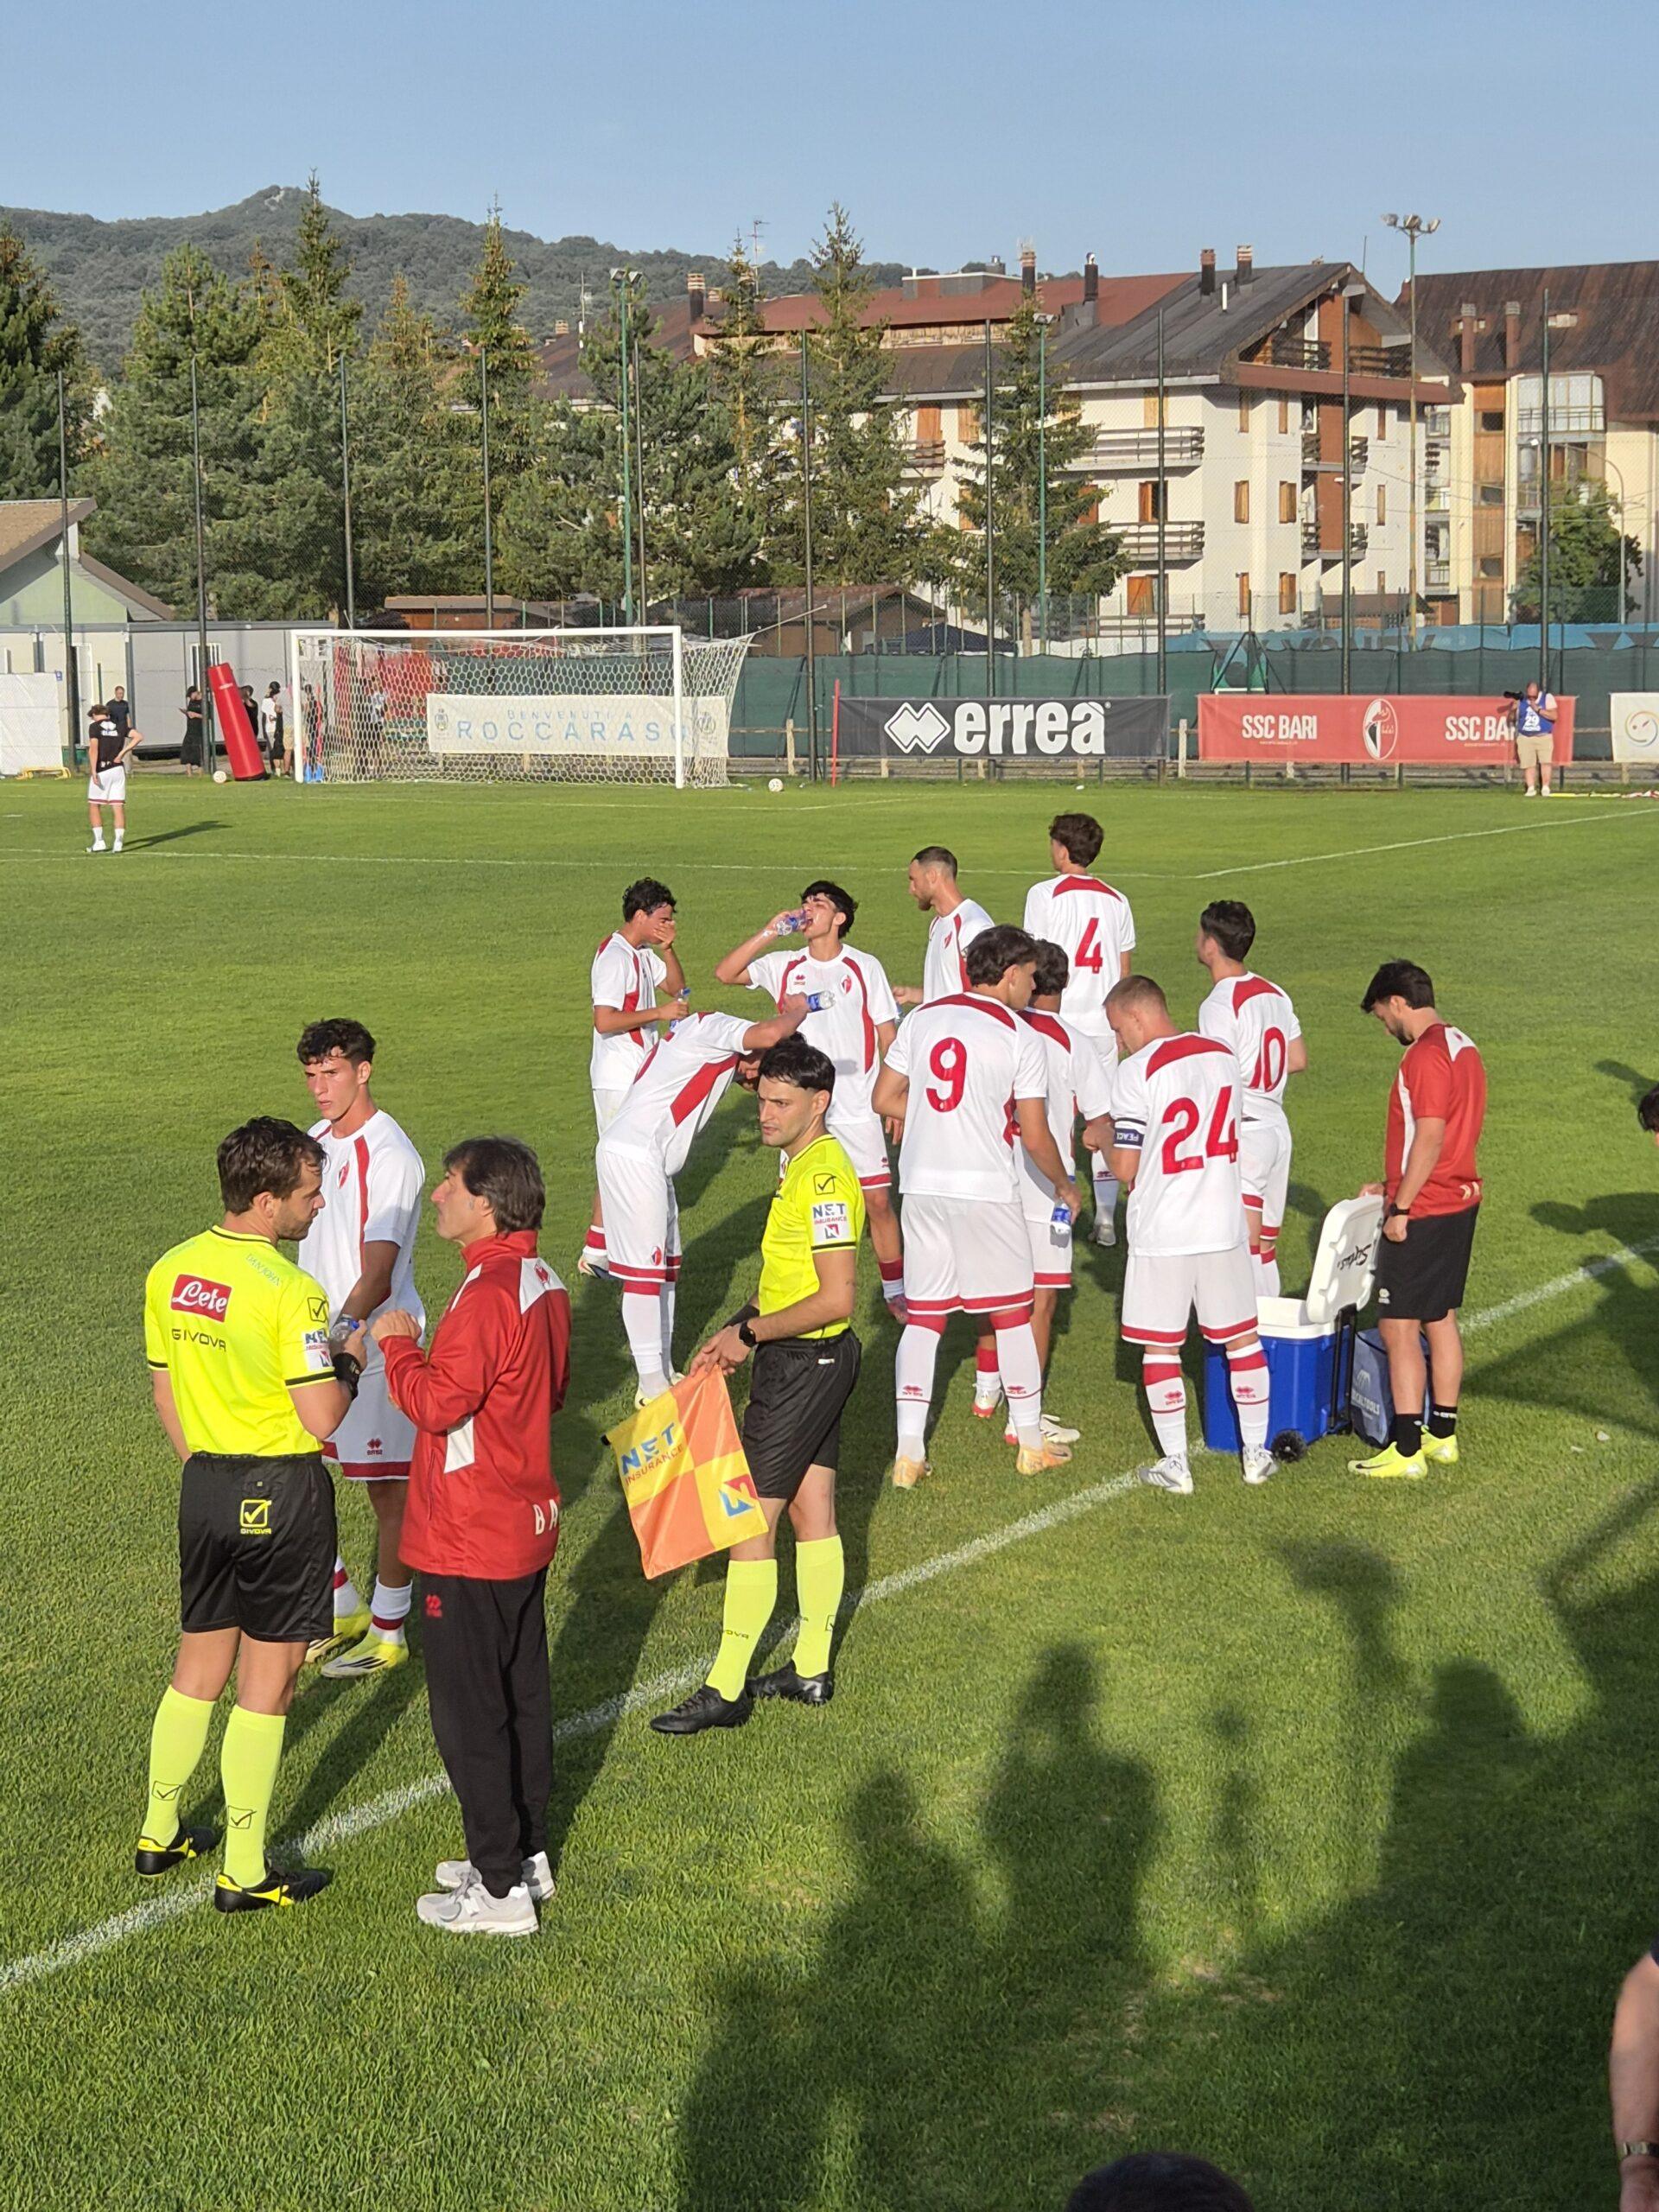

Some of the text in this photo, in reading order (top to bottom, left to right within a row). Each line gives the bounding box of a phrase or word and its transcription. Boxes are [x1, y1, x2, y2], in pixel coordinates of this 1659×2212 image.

[507, 709, 611, 720] BENVENUTI
[1242, 715, 1317, 740] SSC BARI
[1445, 715, 1481, 741] SSC
[1075, 918, 1103, 974] 4
[926, 1037, 967, 1113] 9
[1161, 1085, 1238, 1174] 24
[812, 1204, 845, 1219] NET
[172, 1281, 226, 1313] Lete
[172, 1328, 226, 1351] GIVOVA
[621, 1422, 676, 1475] NET
[625, 1444, 684, 1487] INSURANCE
